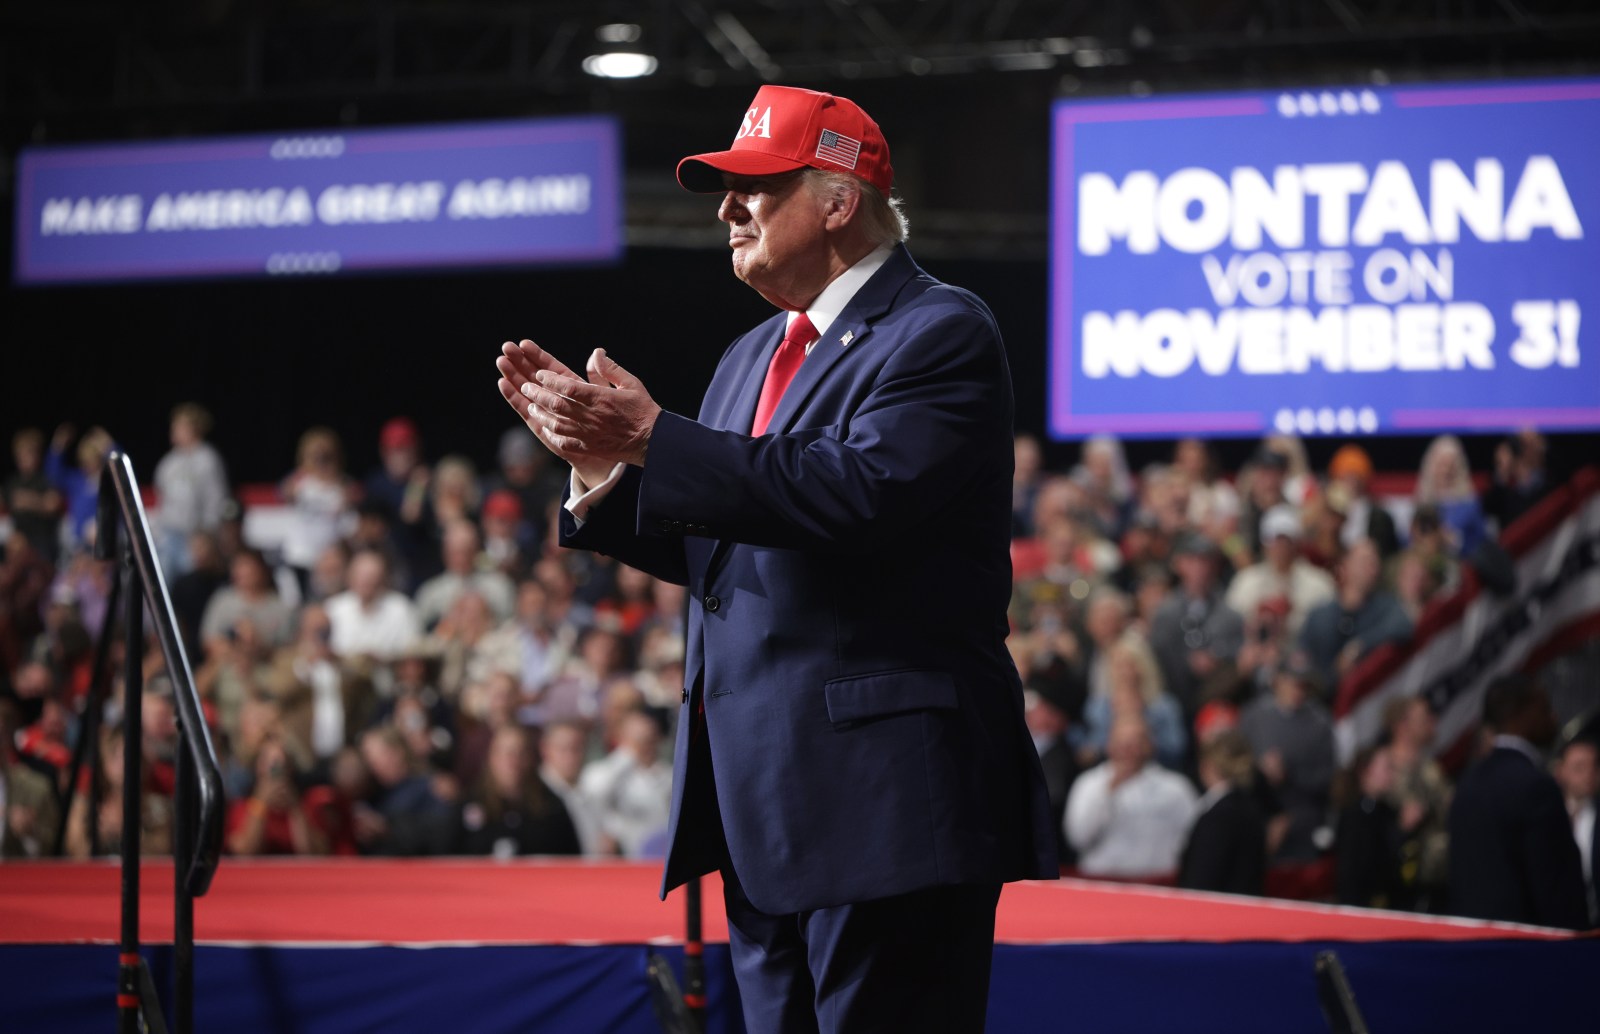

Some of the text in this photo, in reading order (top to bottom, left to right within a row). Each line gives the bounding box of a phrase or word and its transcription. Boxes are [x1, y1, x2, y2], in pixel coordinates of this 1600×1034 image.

[41, 195, 143, 236] MAKE
[146, 187, 314, 232] AMERICA
[317, 181, 446, 225] GREAT
[1078, 155, 1584, 256] MONTANA
[1202, 247, 1454, 307] VOTE ON
[1081, 299, 1581, 379] NOVEMBER 3!
